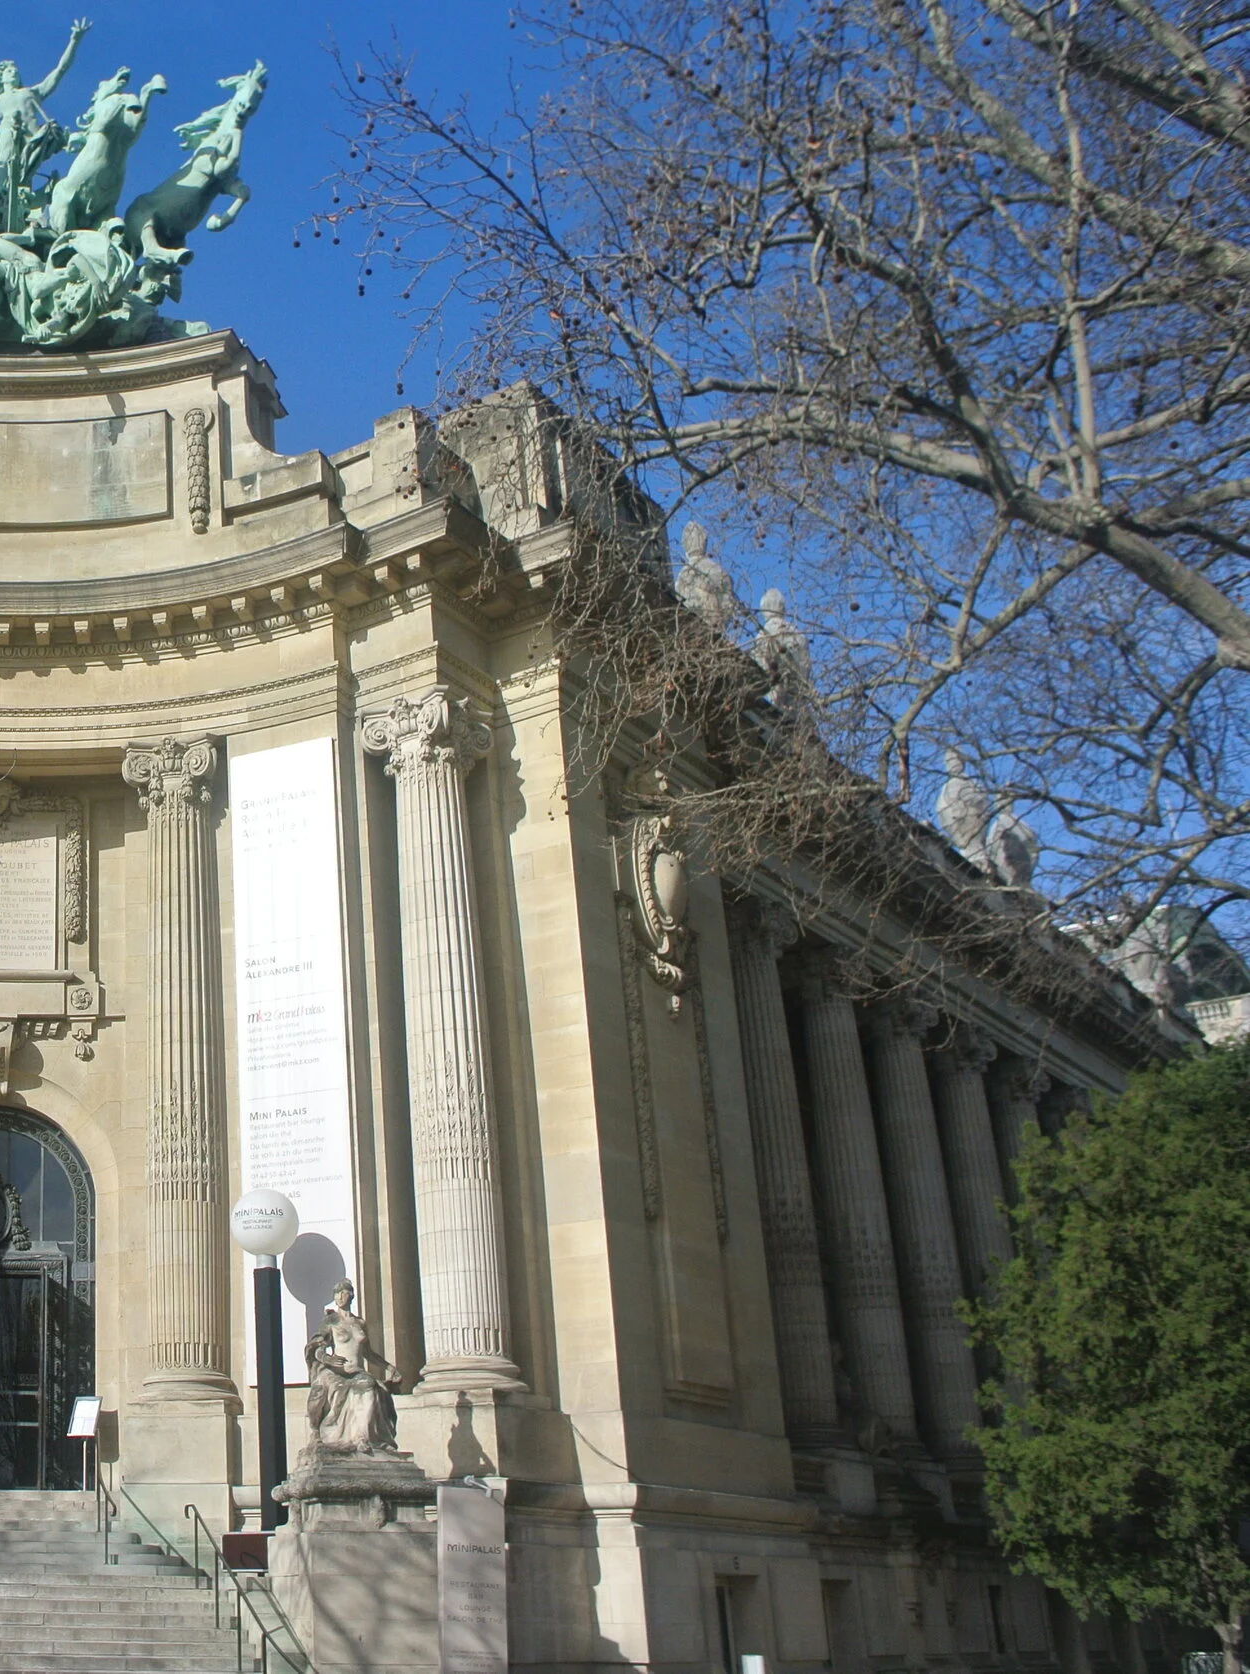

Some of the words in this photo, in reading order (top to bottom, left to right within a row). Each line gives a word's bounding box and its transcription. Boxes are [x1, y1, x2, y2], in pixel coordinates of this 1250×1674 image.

[241, 797, 278, 810] GRAND
[10, 838, 50, 848] PALAIS
[245, 956, 276, 968] SALON
[245, 964, 300, 980] ALEXANDRE
[303, 961, 313, 970] III
[248, 1009, 272, 1024] mk2
[250, 1112, 272, 1121] MINI
[275, 1107, 307, 1118] PALAIS
